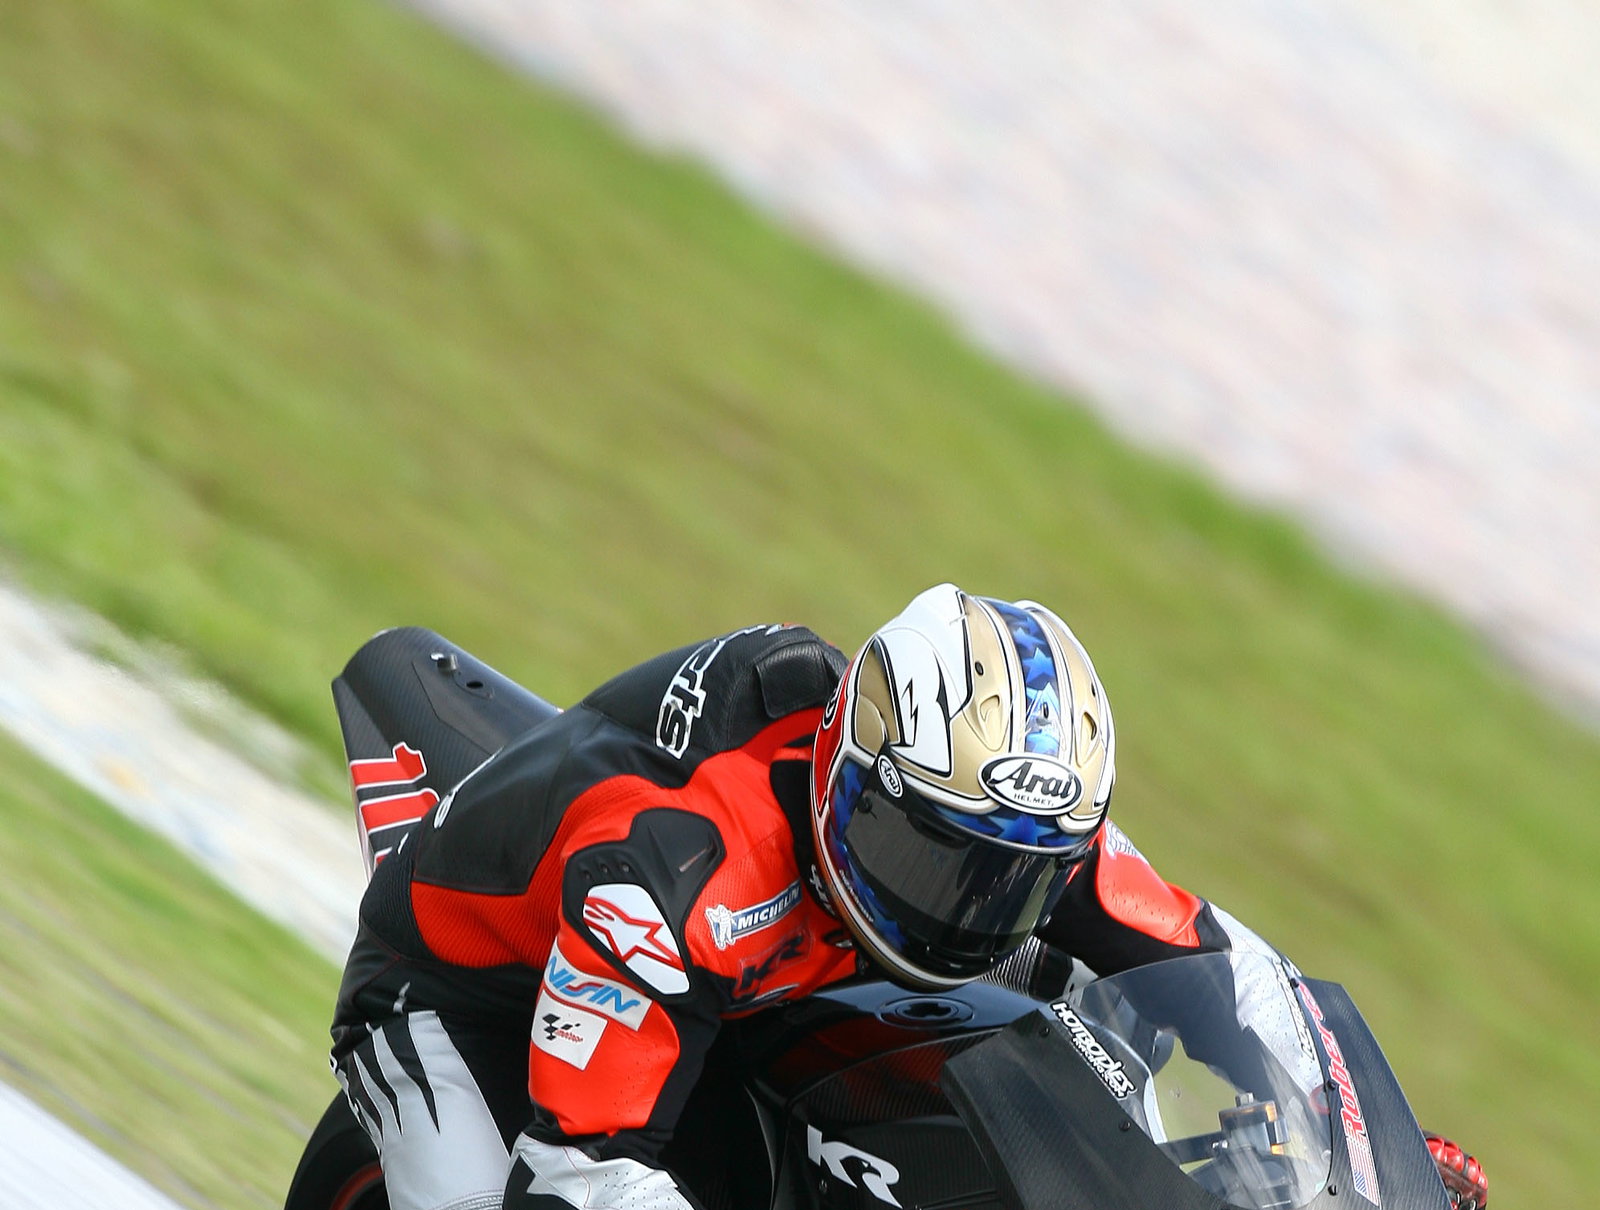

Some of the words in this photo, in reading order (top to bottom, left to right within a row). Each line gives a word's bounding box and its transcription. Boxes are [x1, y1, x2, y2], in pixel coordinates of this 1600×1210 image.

[987, 760, 1074, 800] Arai
[737, 884, 801, 930] MICHELIN
[1052, 1002, 1135, 1094] HOTBODIES
[807, 1125, 903, 1208] KR
